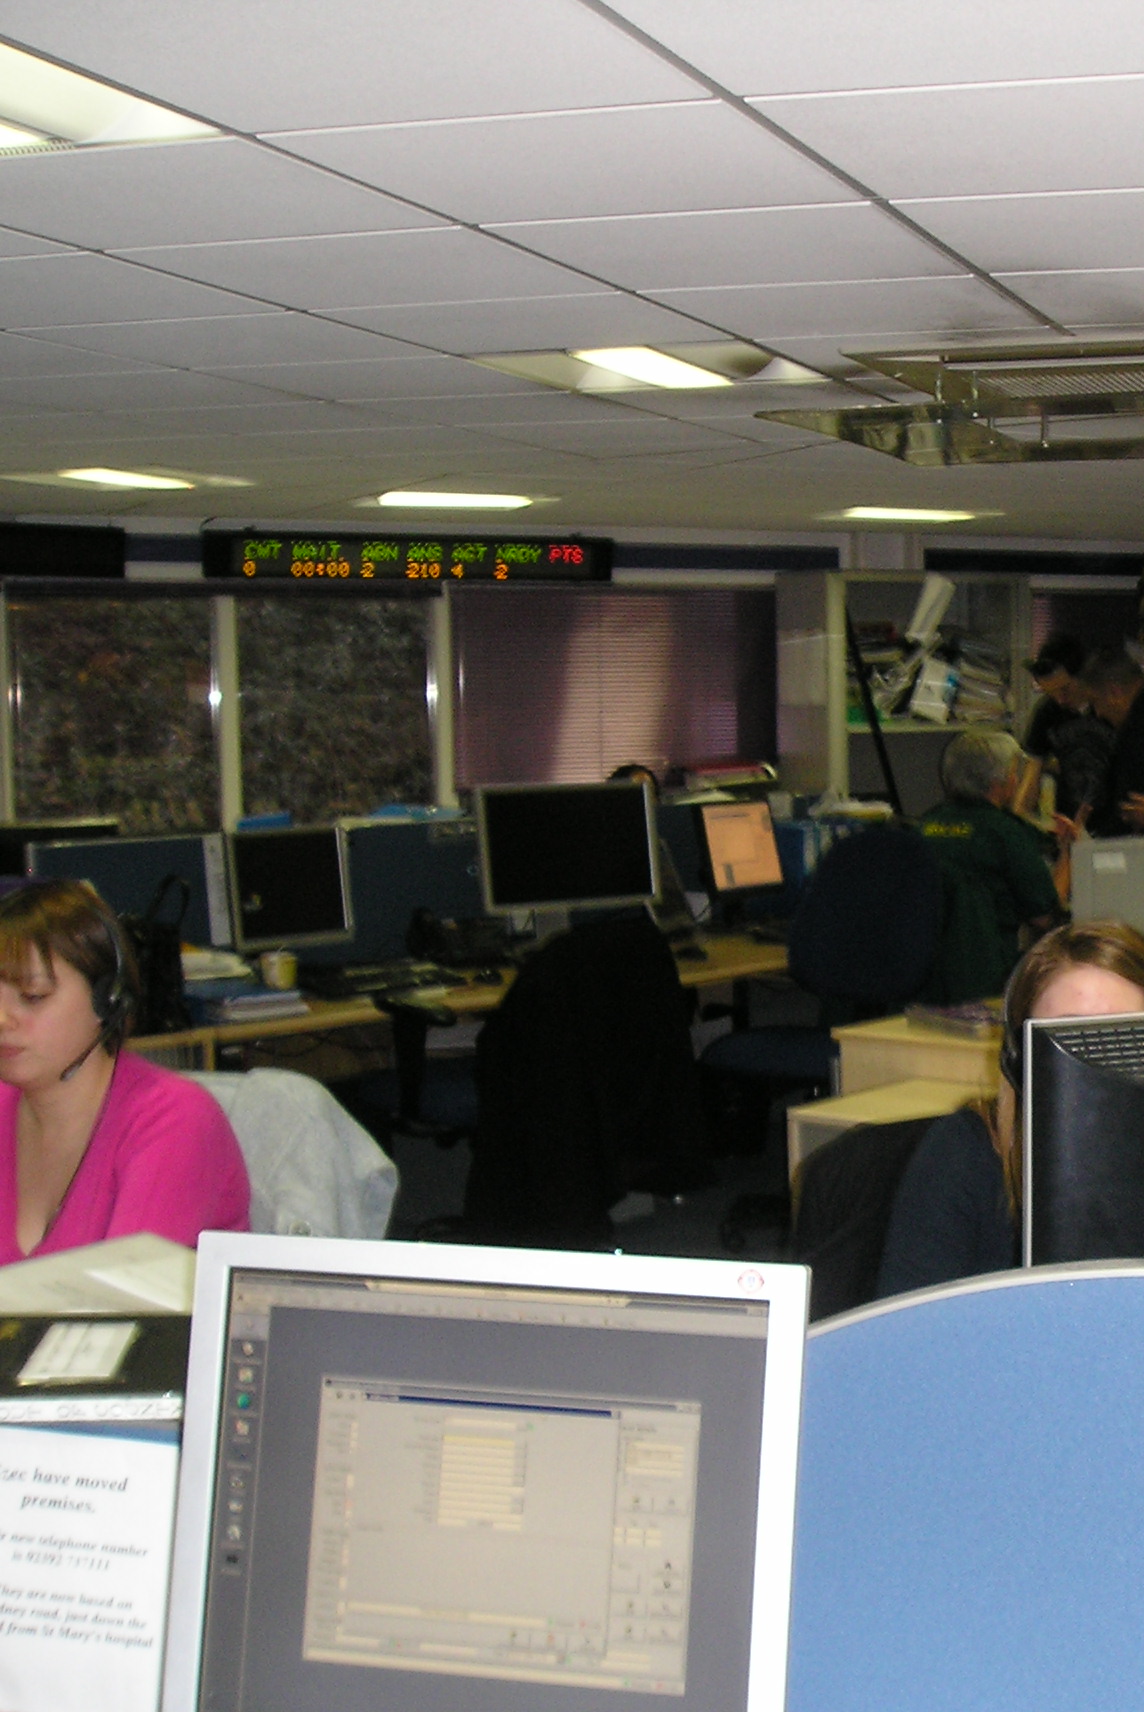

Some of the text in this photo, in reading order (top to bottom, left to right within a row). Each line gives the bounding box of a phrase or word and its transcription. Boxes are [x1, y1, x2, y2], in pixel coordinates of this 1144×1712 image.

[290, 540, 341, 561] WAIT
[549, 544, 584, 565] PTS
[243, 558, 256, 577] 0
[291, 558, 350, 578] 00:00
[360, 558, 375, 578] 2
[32, 1467, 71, 1486] have
[75, 1477, 129, 1492] moved
[20, 1494, 96, 1513] premises.
[10, 1533, 35, 1543] new
[38, 1534, 98, 1551] telephone
[100, 1541, 149, 1557] number
[26, 1588, 47, 1600] are
[79, 1593, 115, 1608] based
[127, 1616, 148, 1630] the
[5, 1621, 38, 1637] from
[104, 1630, 155, 1650] hospital
